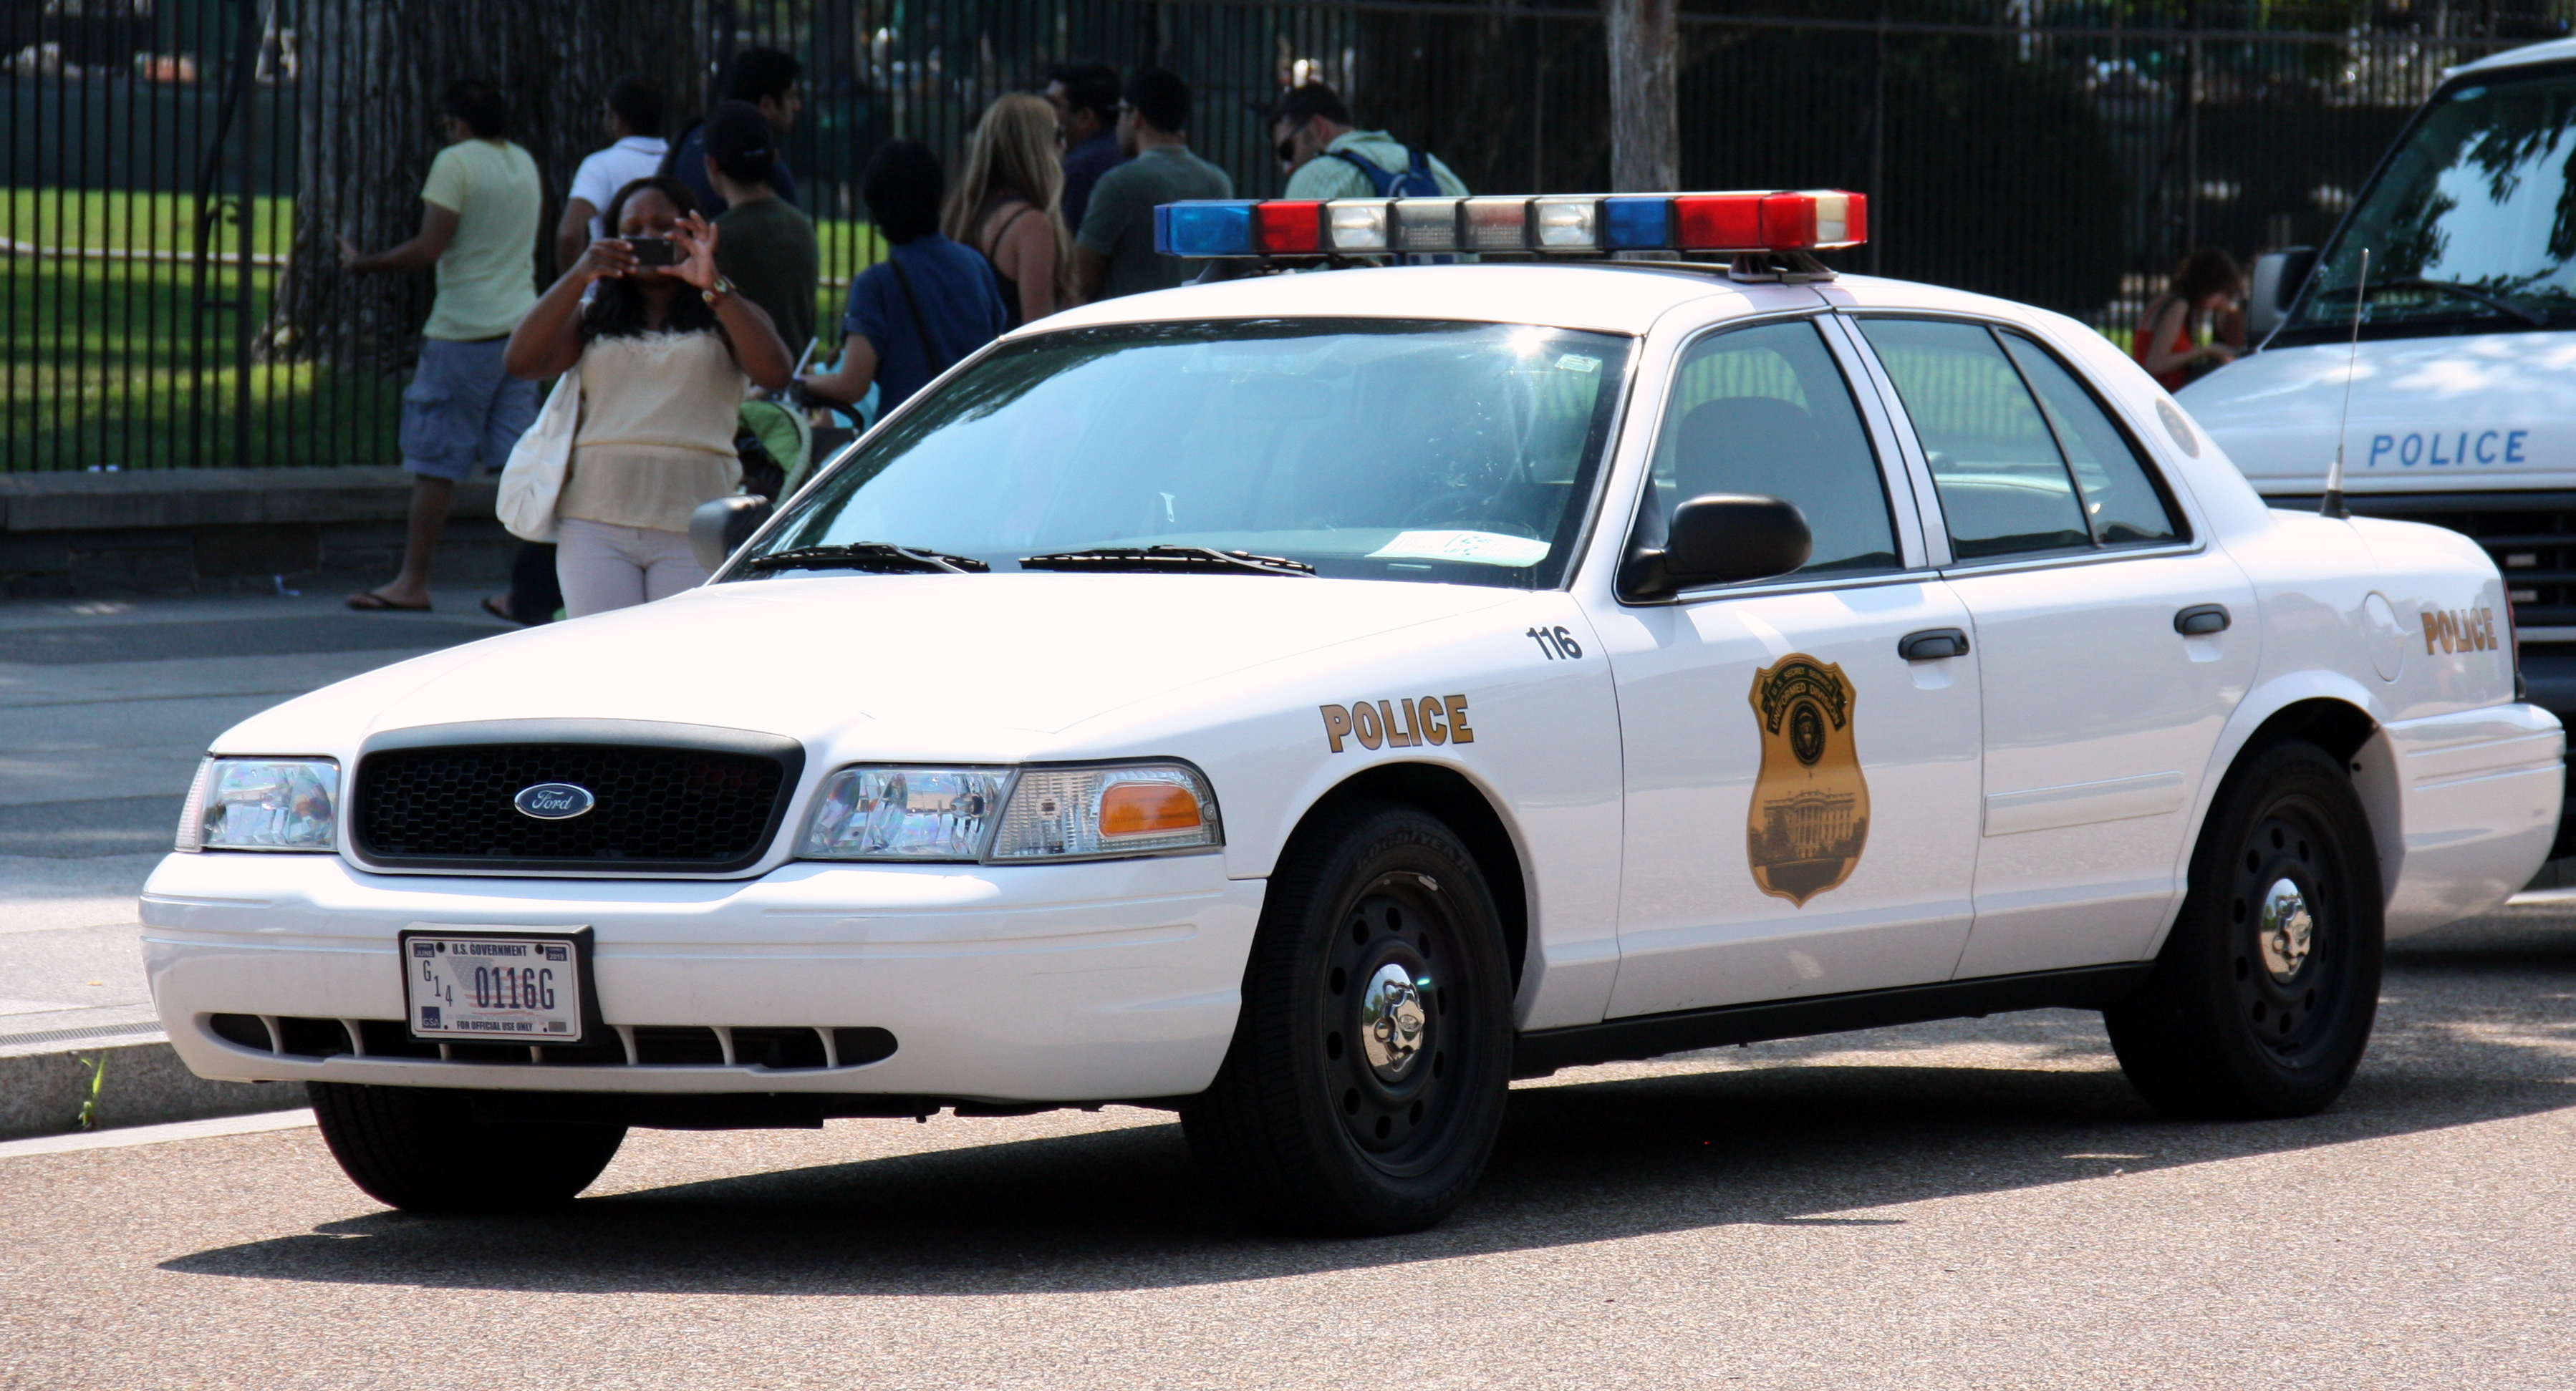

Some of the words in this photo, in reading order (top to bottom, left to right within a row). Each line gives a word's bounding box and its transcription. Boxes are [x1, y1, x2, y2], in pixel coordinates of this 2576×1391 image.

[2368, 430, 2528, 467] POLICE
[1525, 626, 1583, 661] 116
[2421, 607, 2498, 656] POLICE
[1319, 694, 1475, 753] POLICE
[1771, 682, 1806, 730] UNIFORMED
[532, 790, 574, 810] Ford
[452, 943, 468, 955] U.S.
[470, 944, 527, 956] GOVERNMENT
[475, 966, 555, 1010] 0116G
[423, 1018, 440, 1027] GSA
[457, 1020, 470, 1029] FOR
[471, 1021, 501, 1031] OFFICIAL
[502, 1022, 515, 1031] USE
[516, 1022, 533, 1032] ONLY
